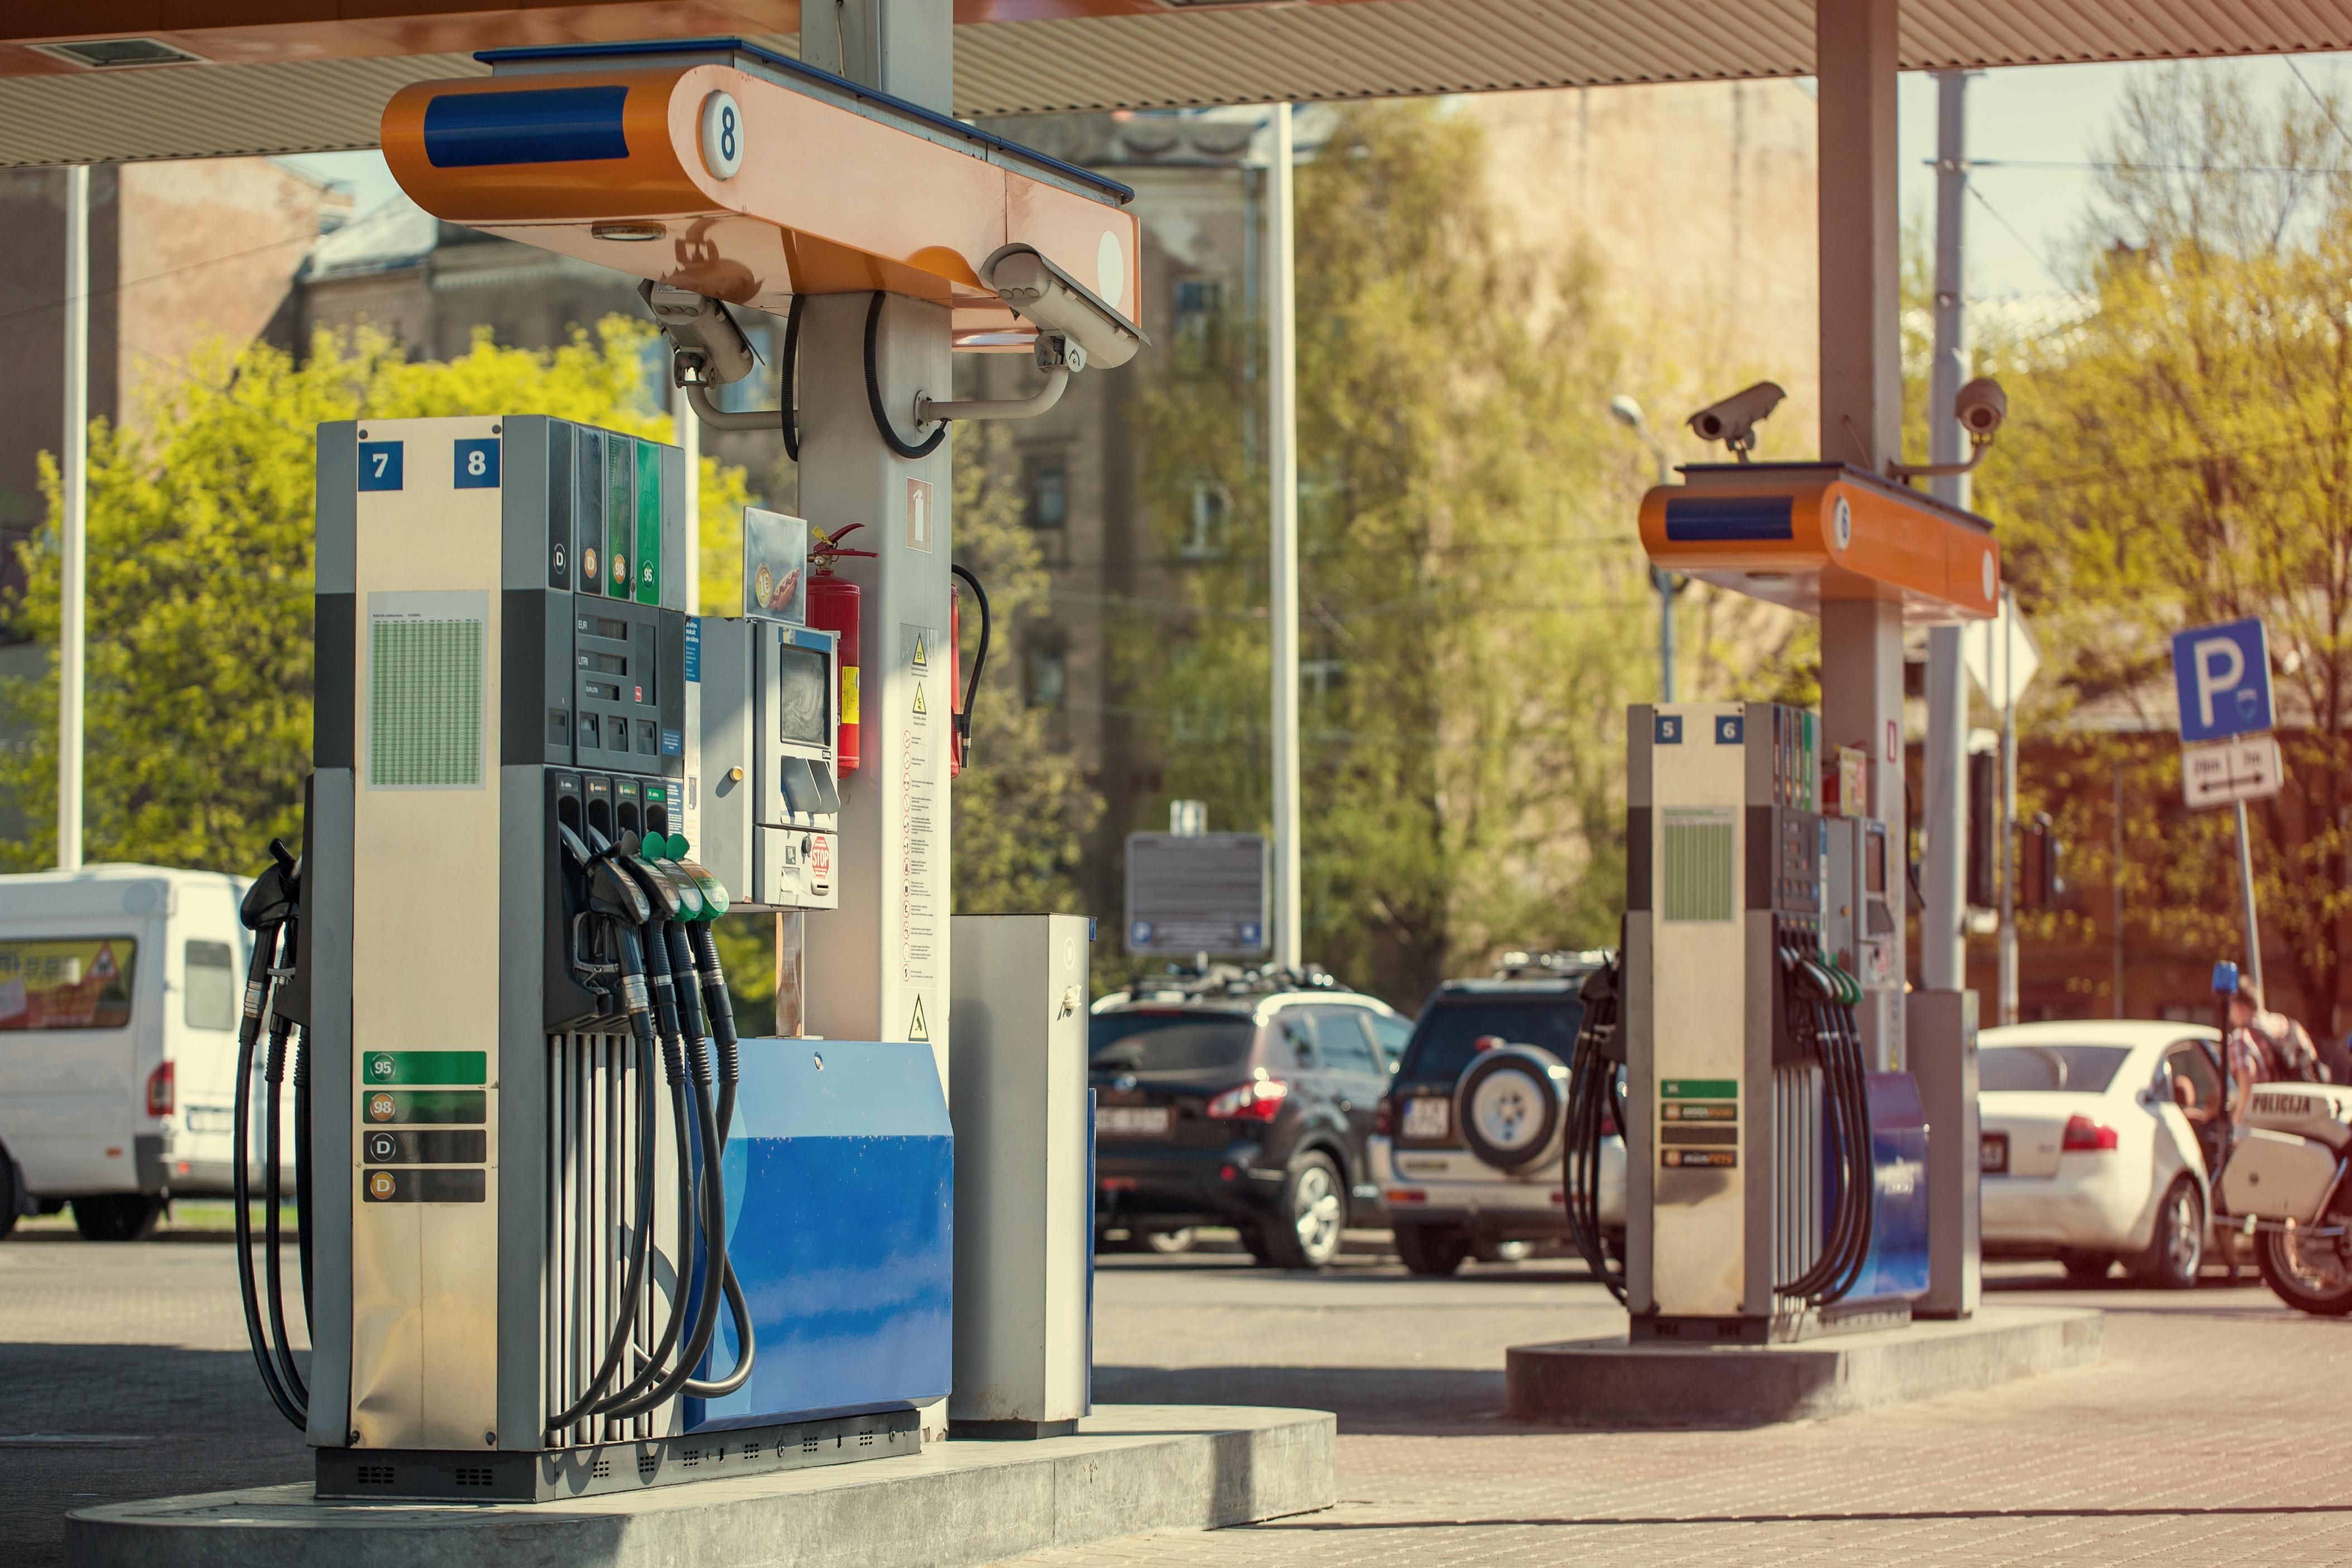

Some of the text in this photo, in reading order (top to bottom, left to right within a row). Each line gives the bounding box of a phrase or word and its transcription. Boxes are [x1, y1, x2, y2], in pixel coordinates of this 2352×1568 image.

[721, 106, 735, 161] 8
[372, 453, 388, 478] 7
[468, 450, 487, 476] 8
[556, 551, 564, 566] D
[587, 556, 595, 570] D
[615, 562, 624, 576] 98
[643, 568, 653, 582] 95
[578, 619, 588, 630] EUR
[578, 656, 589, 666] LITRI
[917, 651, 923, 660] EX
[2194, 636, 2245, 729] P
[1662, 720, 1674, 739] 5
[1723, 722, 1737, 739] 6
[812, 848, 829, 868] STOP
[374, 1061, 391, 1074] 95
[374, 1101, 391, 1113] 98
[2252, 1092, 2311, 1114] POLICIJA
[377, 1141, 390, 1154] D
[377, 1179, 390, 1192] D
